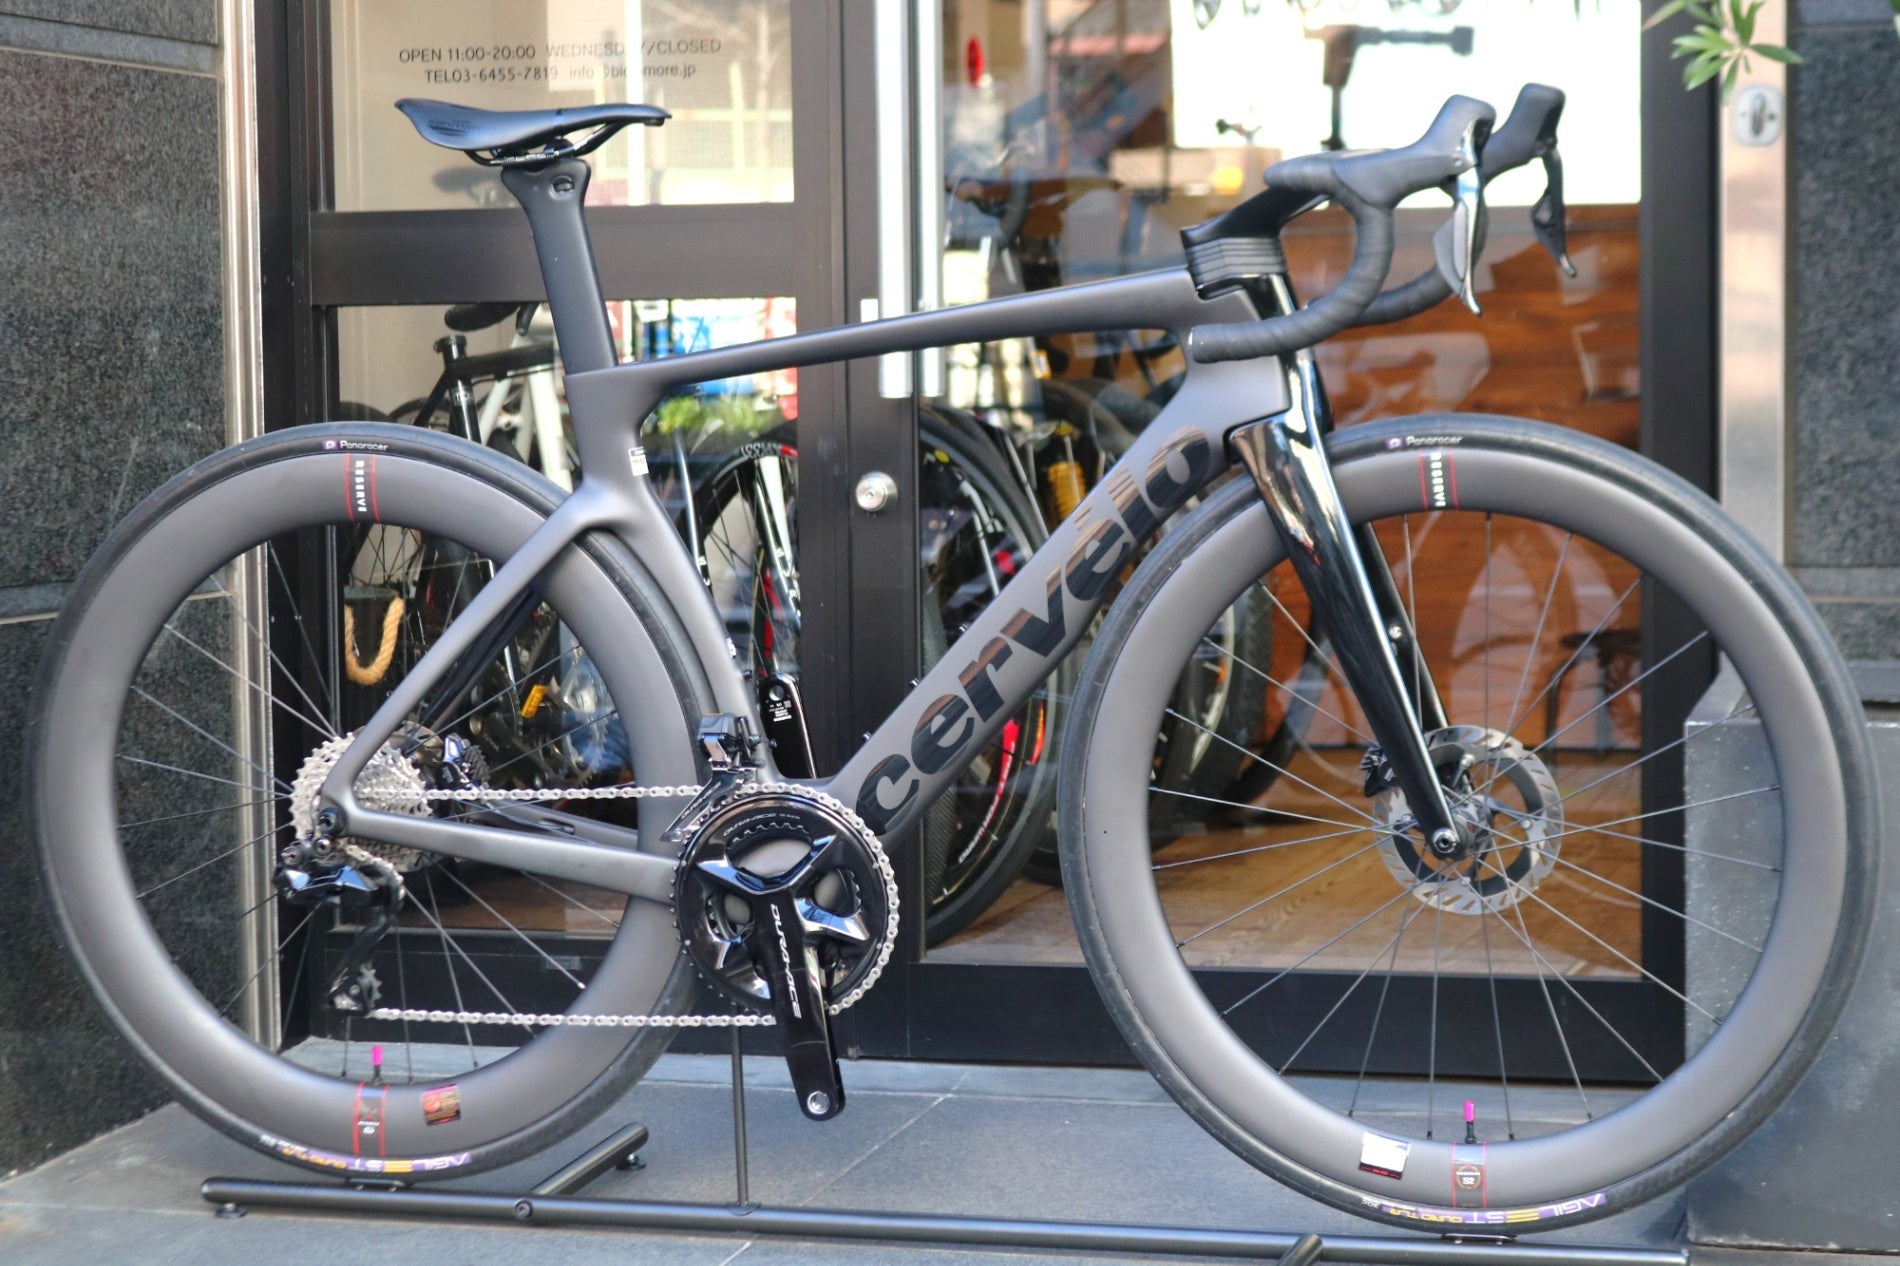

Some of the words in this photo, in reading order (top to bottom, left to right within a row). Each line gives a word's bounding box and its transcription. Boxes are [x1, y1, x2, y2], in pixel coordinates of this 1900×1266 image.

[399, 48, 442, 63] OPEN
[448, 45, 536, 61] 11:00-20:00
[546, 38, 722, 58] WEDNESD/CLOSED
[339, 440, 389, 451] Panaracer
[1405, 435, 1463, 446] Panaracer
[770, 903, 802, 1019] DURA-ACE
